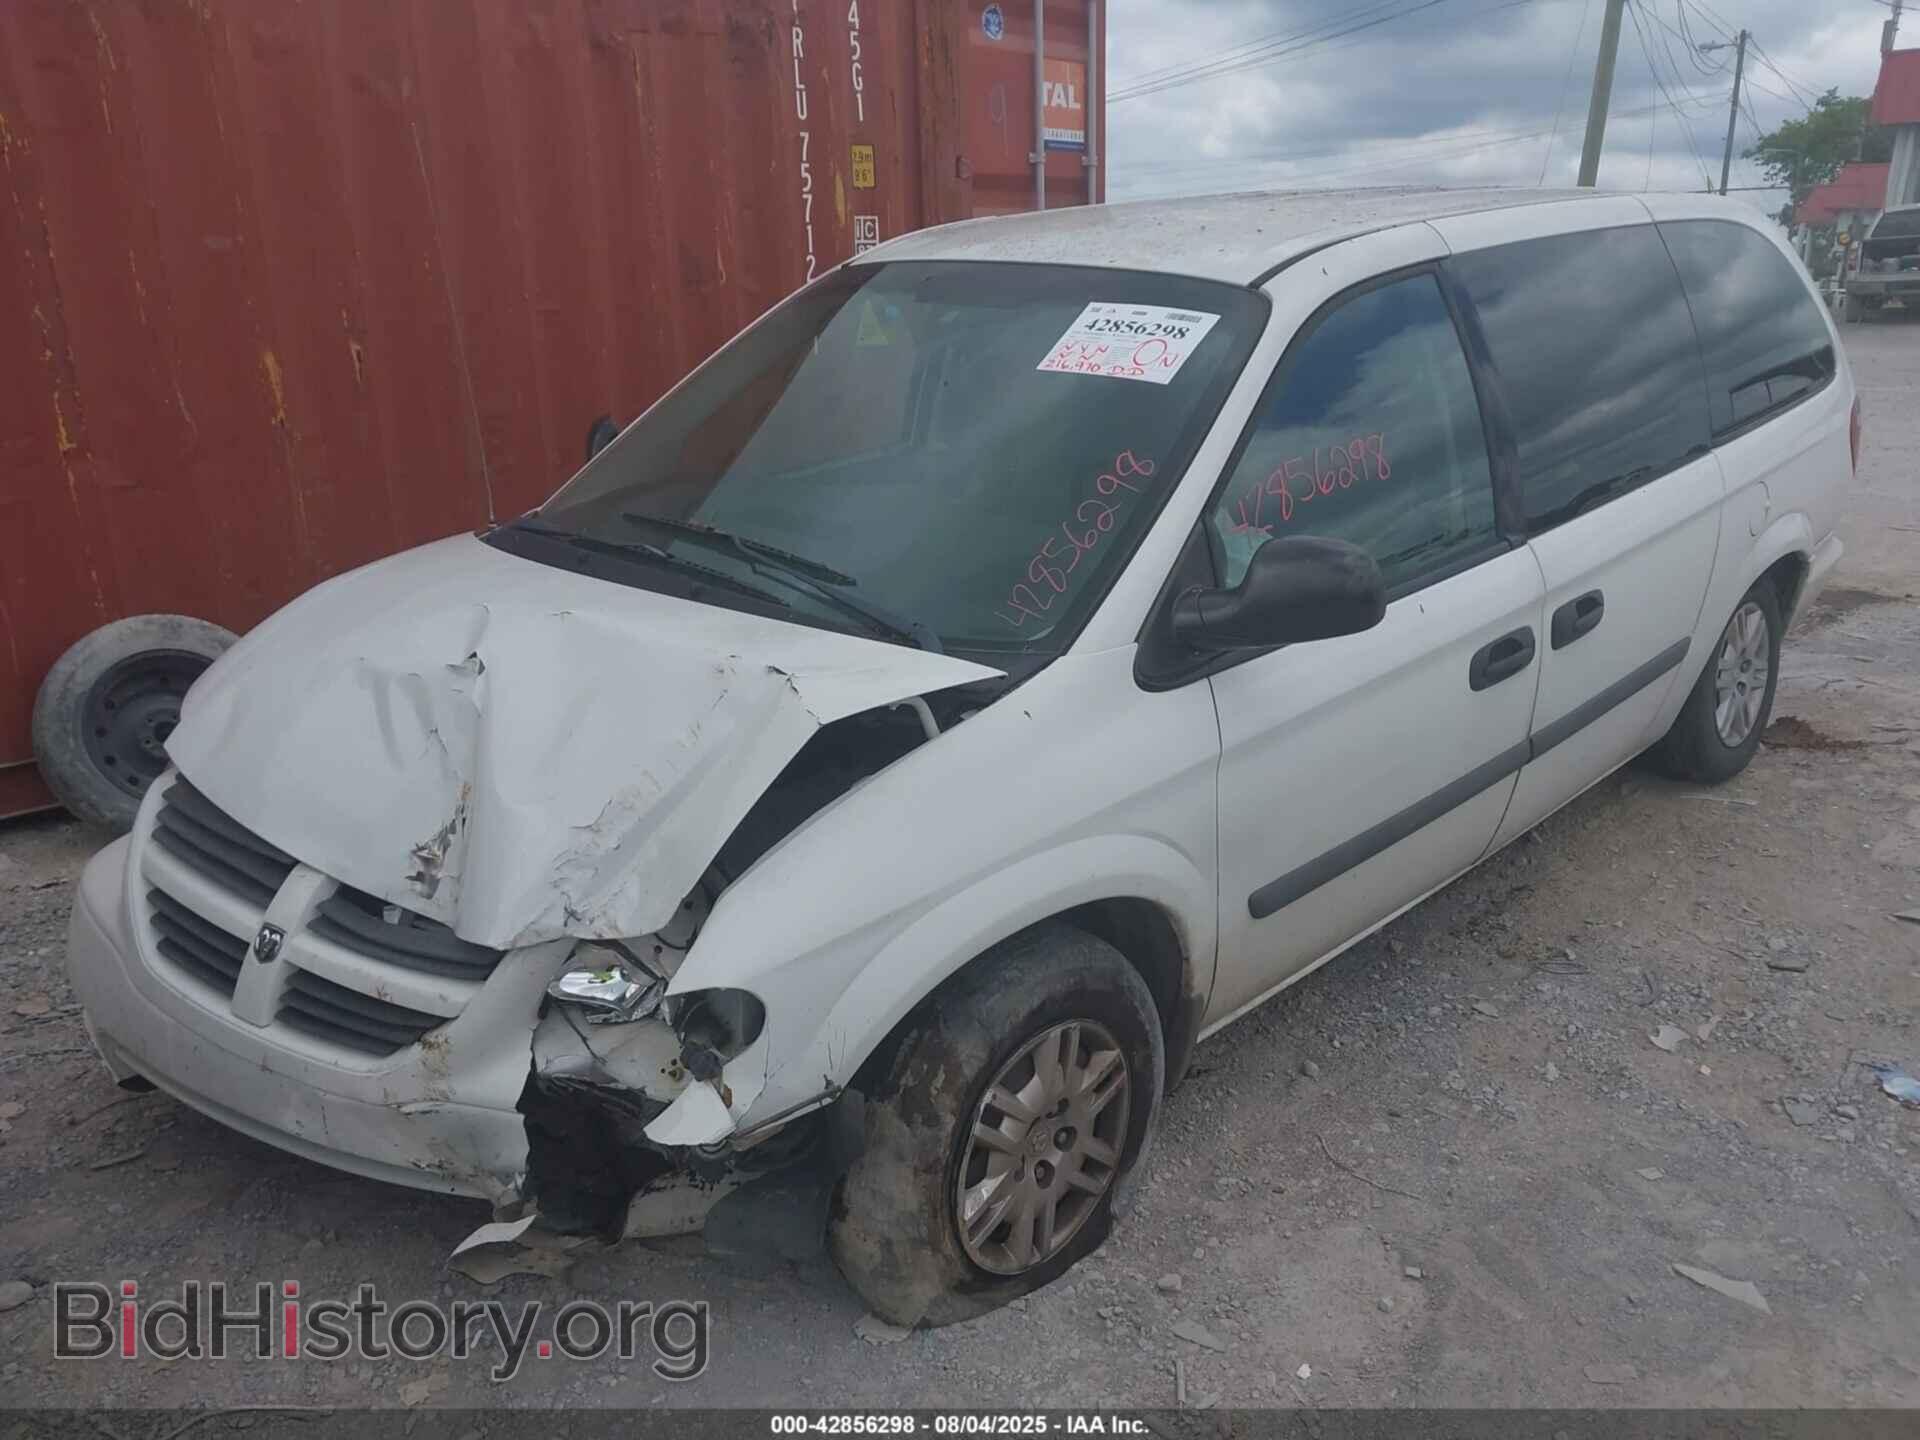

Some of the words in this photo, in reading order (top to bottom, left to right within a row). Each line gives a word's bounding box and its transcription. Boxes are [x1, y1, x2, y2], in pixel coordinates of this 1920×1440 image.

[848, 0, 864, 122] 45G1
[799, 132, 816, 282] 75712
[1084, 318, 1191, 340] 42856298
[994, 449, 1155, 627] 42856298
[1231, 432, 1391, 534] 42856298
